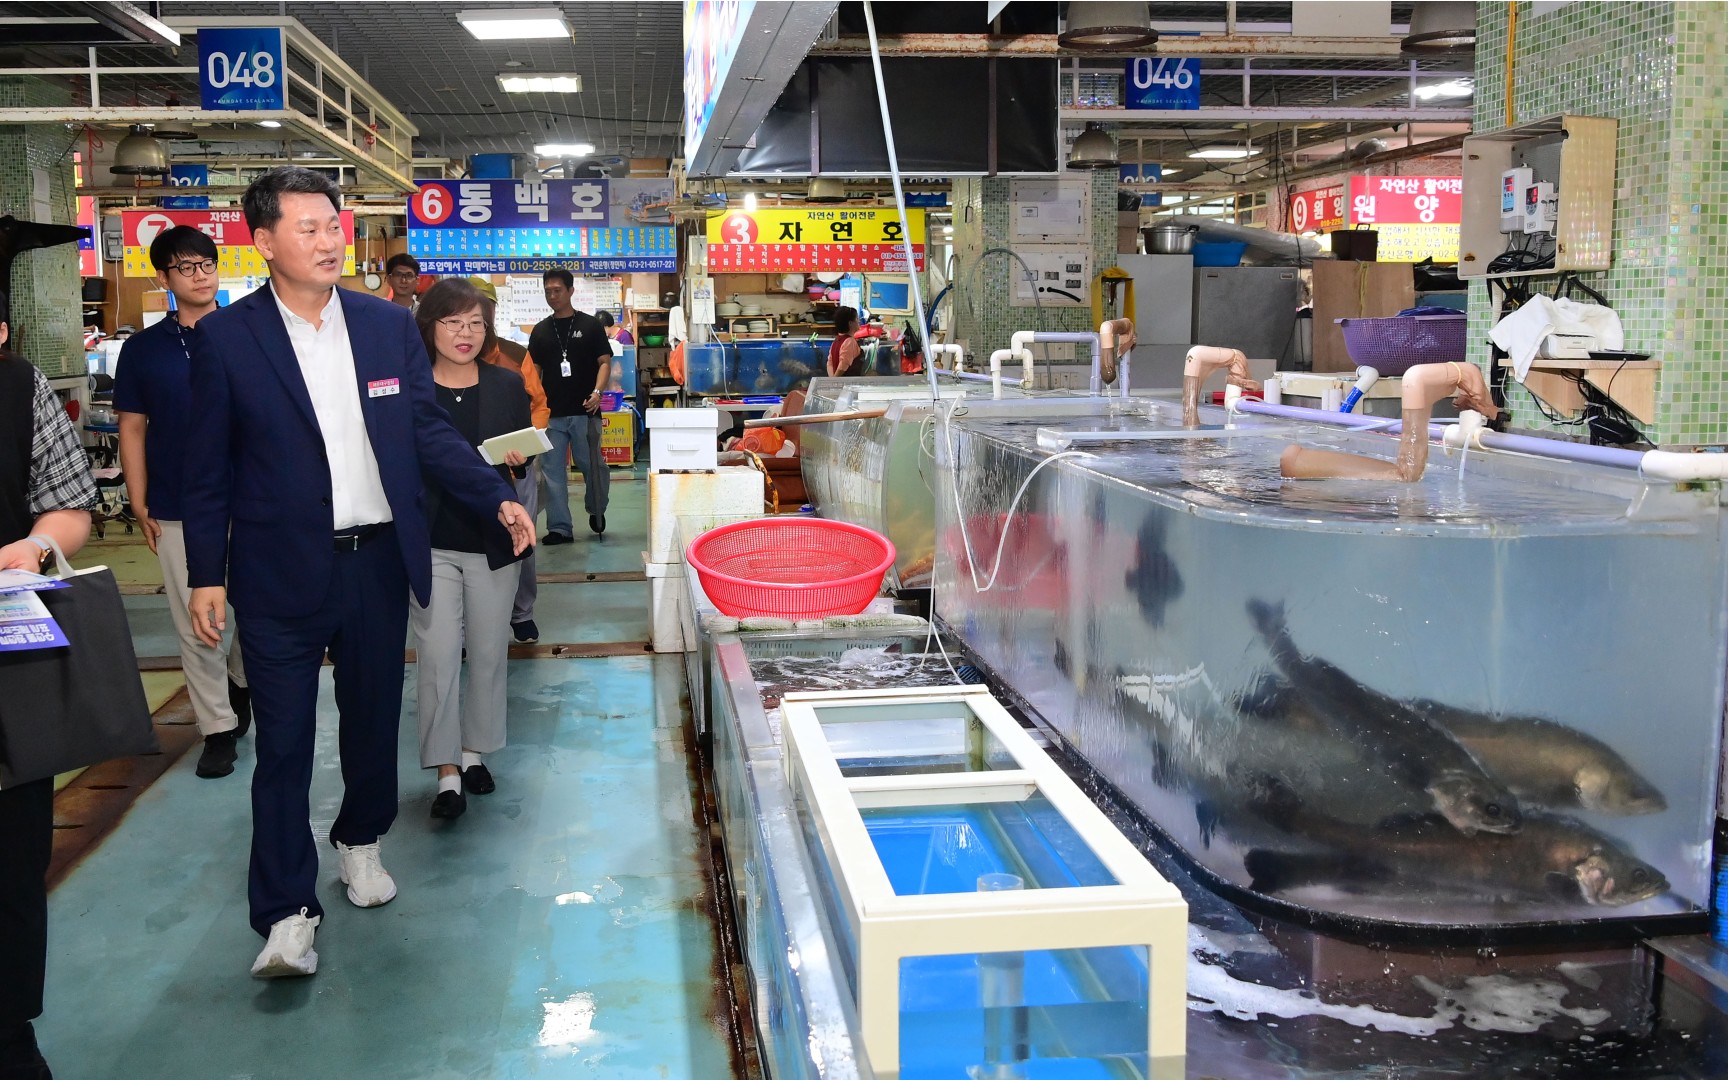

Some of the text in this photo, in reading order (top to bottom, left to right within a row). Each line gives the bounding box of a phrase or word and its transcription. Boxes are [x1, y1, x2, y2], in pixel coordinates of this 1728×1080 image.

[208, 51, 275, 88] 048
[1133, 57, 1193, 89] 046
[1379, 179, 1420, 194] 자연산
[209, 211, 241, 222] 자연산
[422, 188, 443, 220] 6
[458, 182, 604, 224] 동백호
[807, 211, 876, 220] 자연산 활어전문
[1293, 196, 1308, 231] 9
[729, 217, 751, 244] 3
[778, 221, 904, 242] 자연호
[464, 261, 506, 272] 판매하는집
[509, 260, 586, 271] 010-2553-3281
[628, 260, 675, 269] 473-21-0517-221
